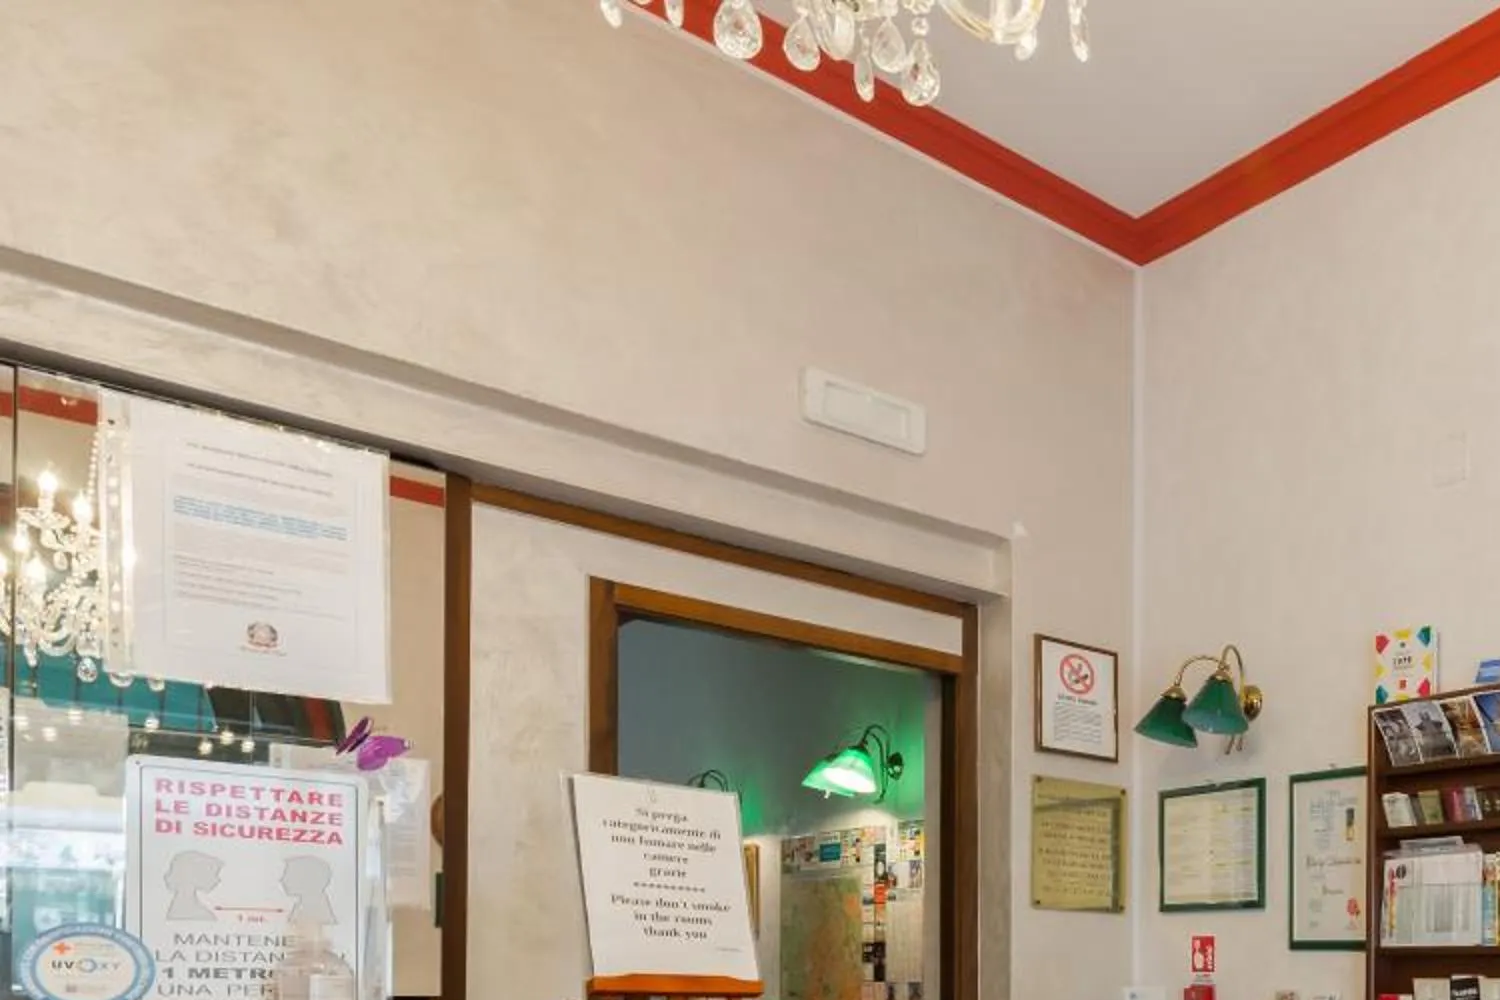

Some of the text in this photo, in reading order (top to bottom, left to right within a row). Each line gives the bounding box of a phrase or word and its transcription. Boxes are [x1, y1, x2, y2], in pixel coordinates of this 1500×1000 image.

[155, 778, 342, 807] RISPETTARE
[155, 798, 342, 827] LE DISTANZE
[155, 819, 343, 845] DI SICUREZZA
[173, 933, 299, 948] MANTENE
[155, 949, 286, 964] LA DISTAN
[162, 967, 174, 979] 1
[157, 983, 212, 997] UNA
